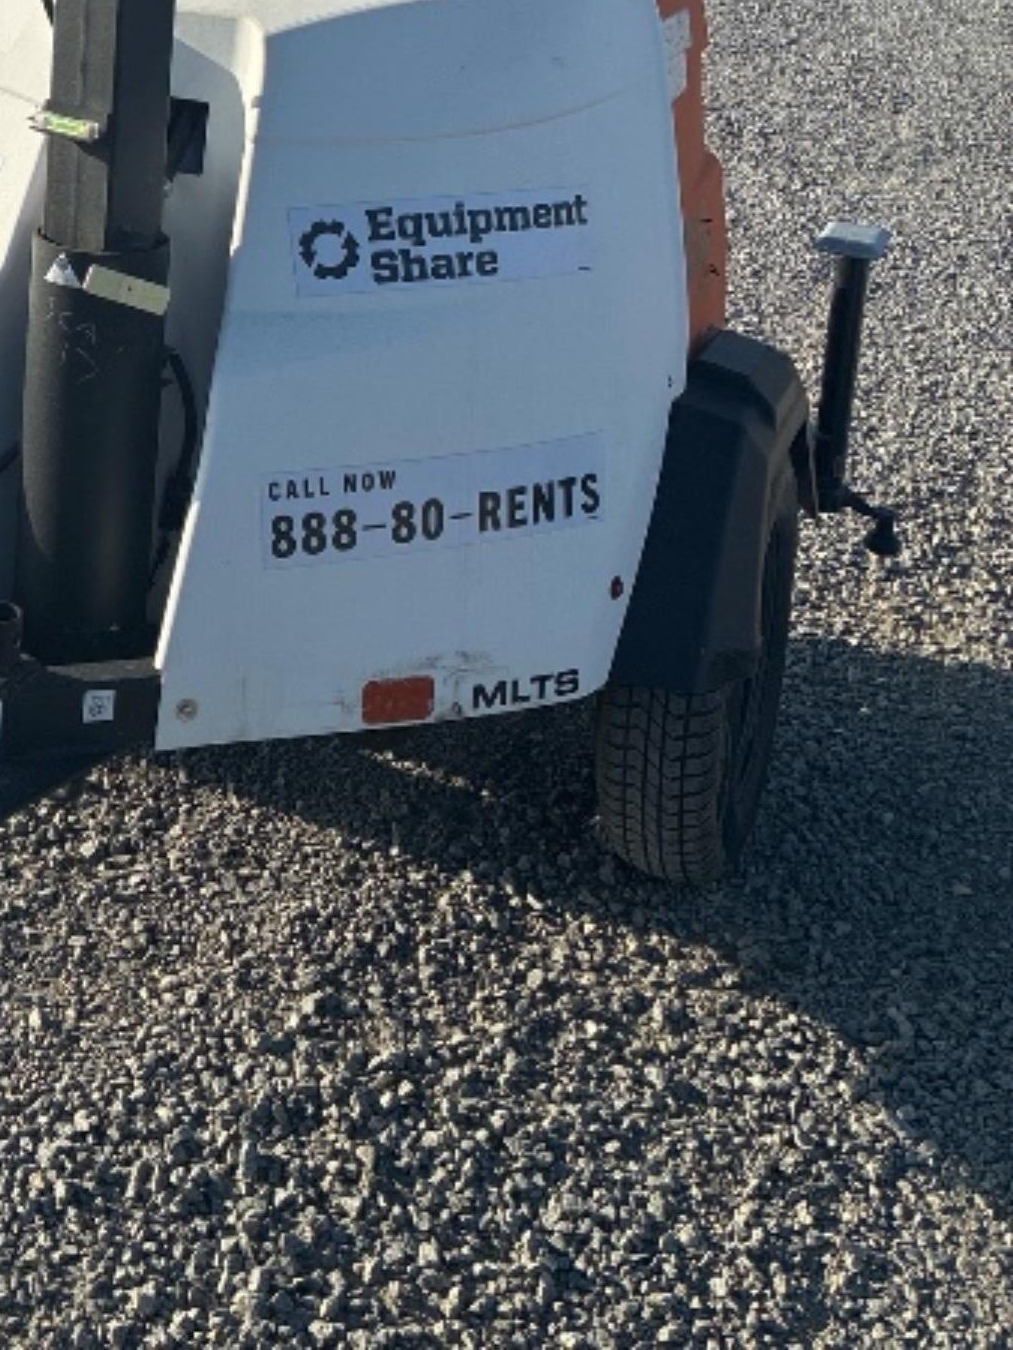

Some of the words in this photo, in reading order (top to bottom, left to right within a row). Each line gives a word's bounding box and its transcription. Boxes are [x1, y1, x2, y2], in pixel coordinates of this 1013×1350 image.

[364, 194, 588, 247] Equipment
[370, 248, 499, 285] Share
[268, 476, 330, 500] CALL
[343, 470, 397, 493] NOW
[271, 473, 601, 559] 888-80-RENTS
[472, 667, 580, 709] MLTS
